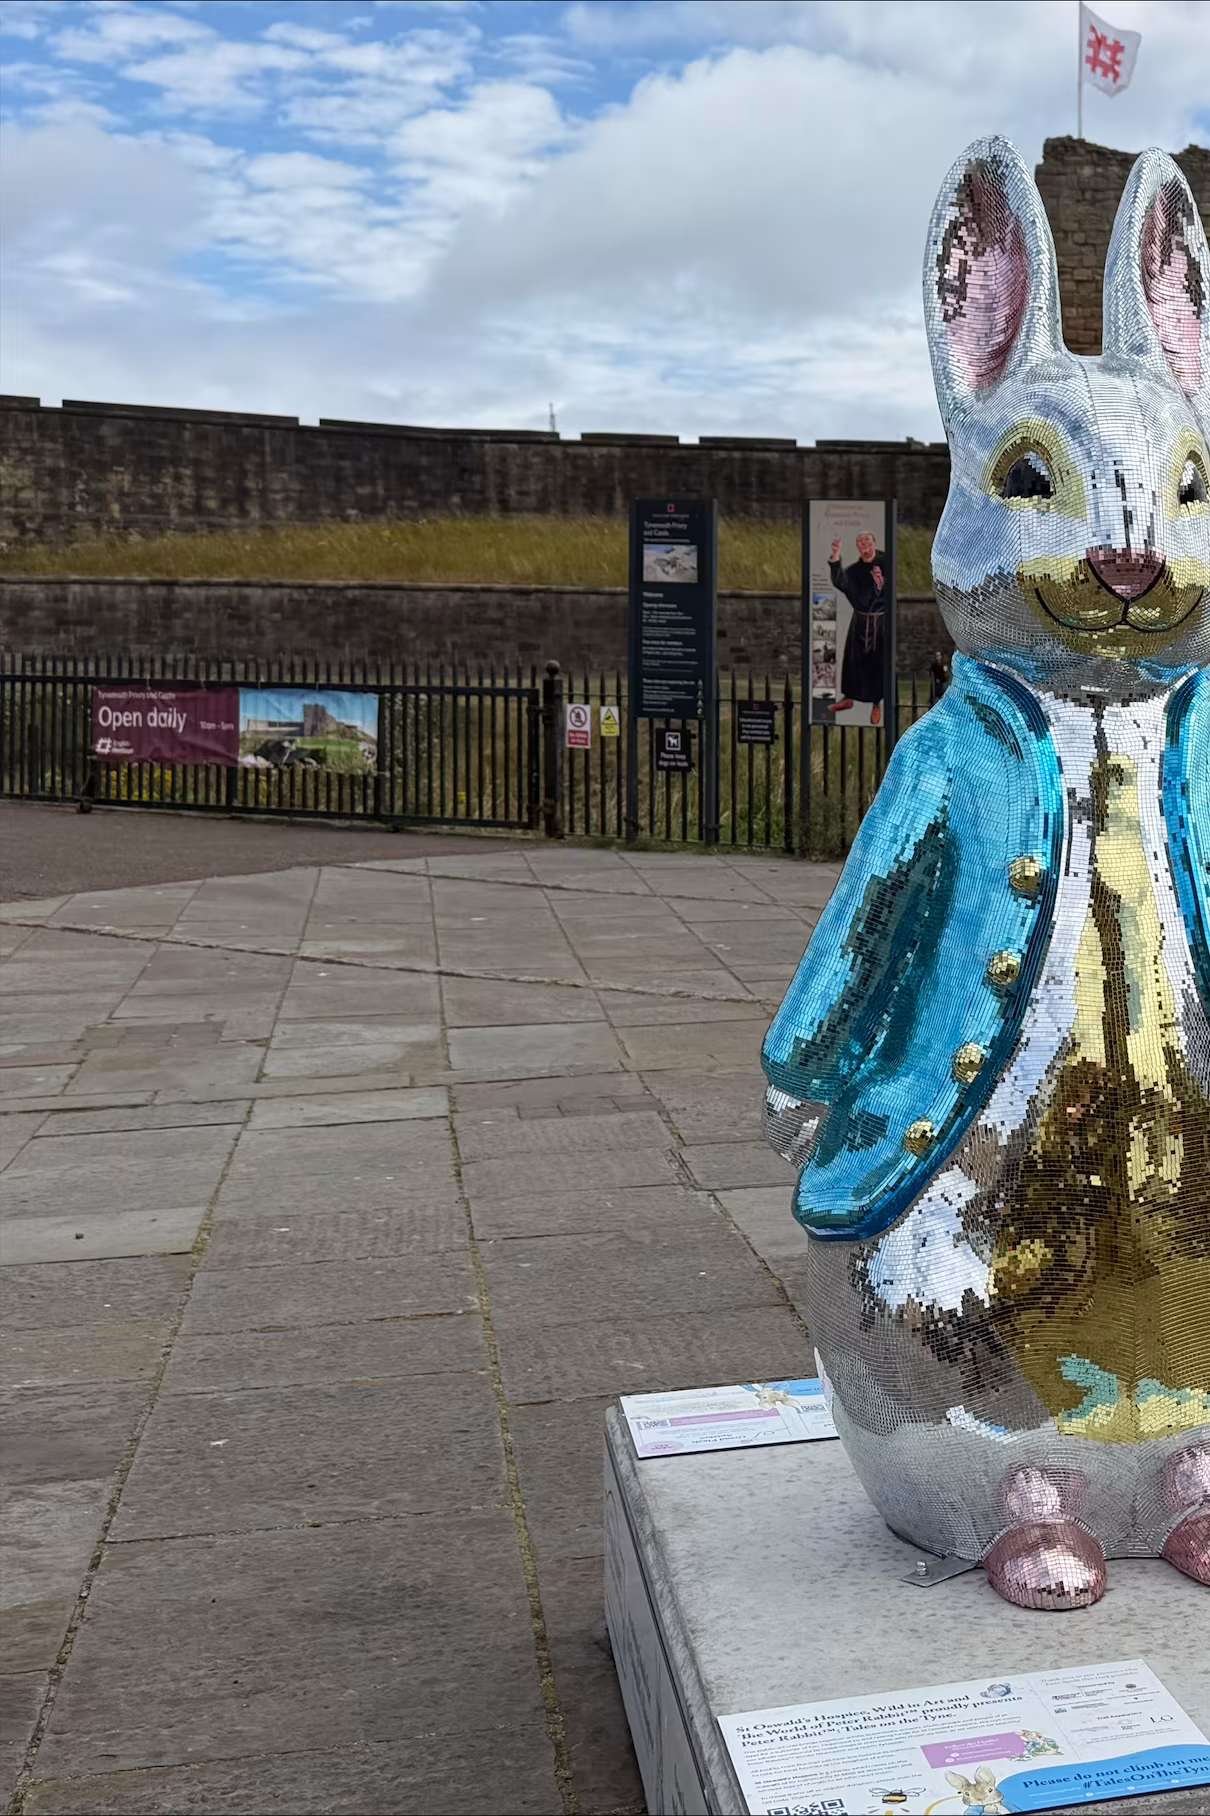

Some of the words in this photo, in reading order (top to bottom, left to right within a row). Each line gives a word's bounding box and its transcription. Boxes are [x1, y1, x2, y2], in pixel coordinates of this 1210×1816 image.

[99, 706, 142, 731] Open
[147, 706, 187, 733] daily
[753, 1718, 811, 1730] Oswald's
[814, 1711, 870, 1721] Hospice,
[872, 1704, 904, 1712] Wild
[766, 1725, 807, 1735] World
[827, 1719, 859, 1727] Peter
[922, 1703, 969, 1715] proudly
[972, 1697, 1022, 1708] presents
[742, 1739, 775, 1747] Peter
[841, 1724, 876, 1732] Tales
[919, 1713, 956, 1721] Tyne.
[1023, 1777, 1070, 1788] Please
[1123, 1762, 1164, 1773] climb
